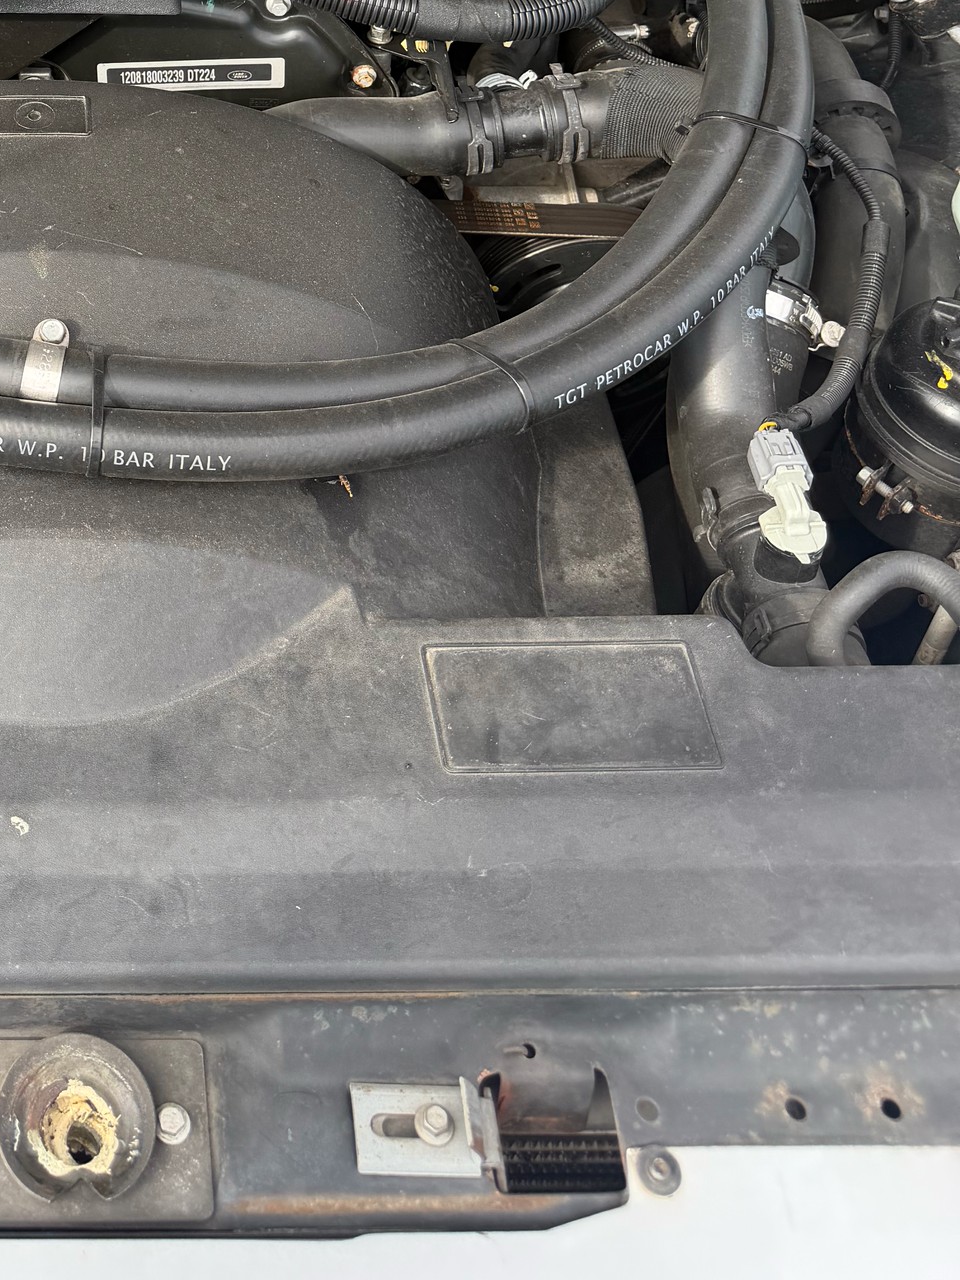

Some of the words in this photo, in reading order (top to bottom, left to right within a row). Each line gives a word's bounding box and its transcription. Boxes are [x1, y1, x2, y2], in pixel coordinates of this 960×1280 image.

[120, 70, 184, 85] 120818003239
[187, 68, 216, 82] DT224
[554, 382, 588, 409] TGT
[596, 333, 672, 390] PETROCAR
[677, 310, 704, 336] W.P.
[710, 288, 725, 309] 10
[726, 265, 746, 294] BAR
[17, 439, 63, 460] W.P.
[113, 449, 155, 469] BAR
[169, 454, 232, 471] ITALY
